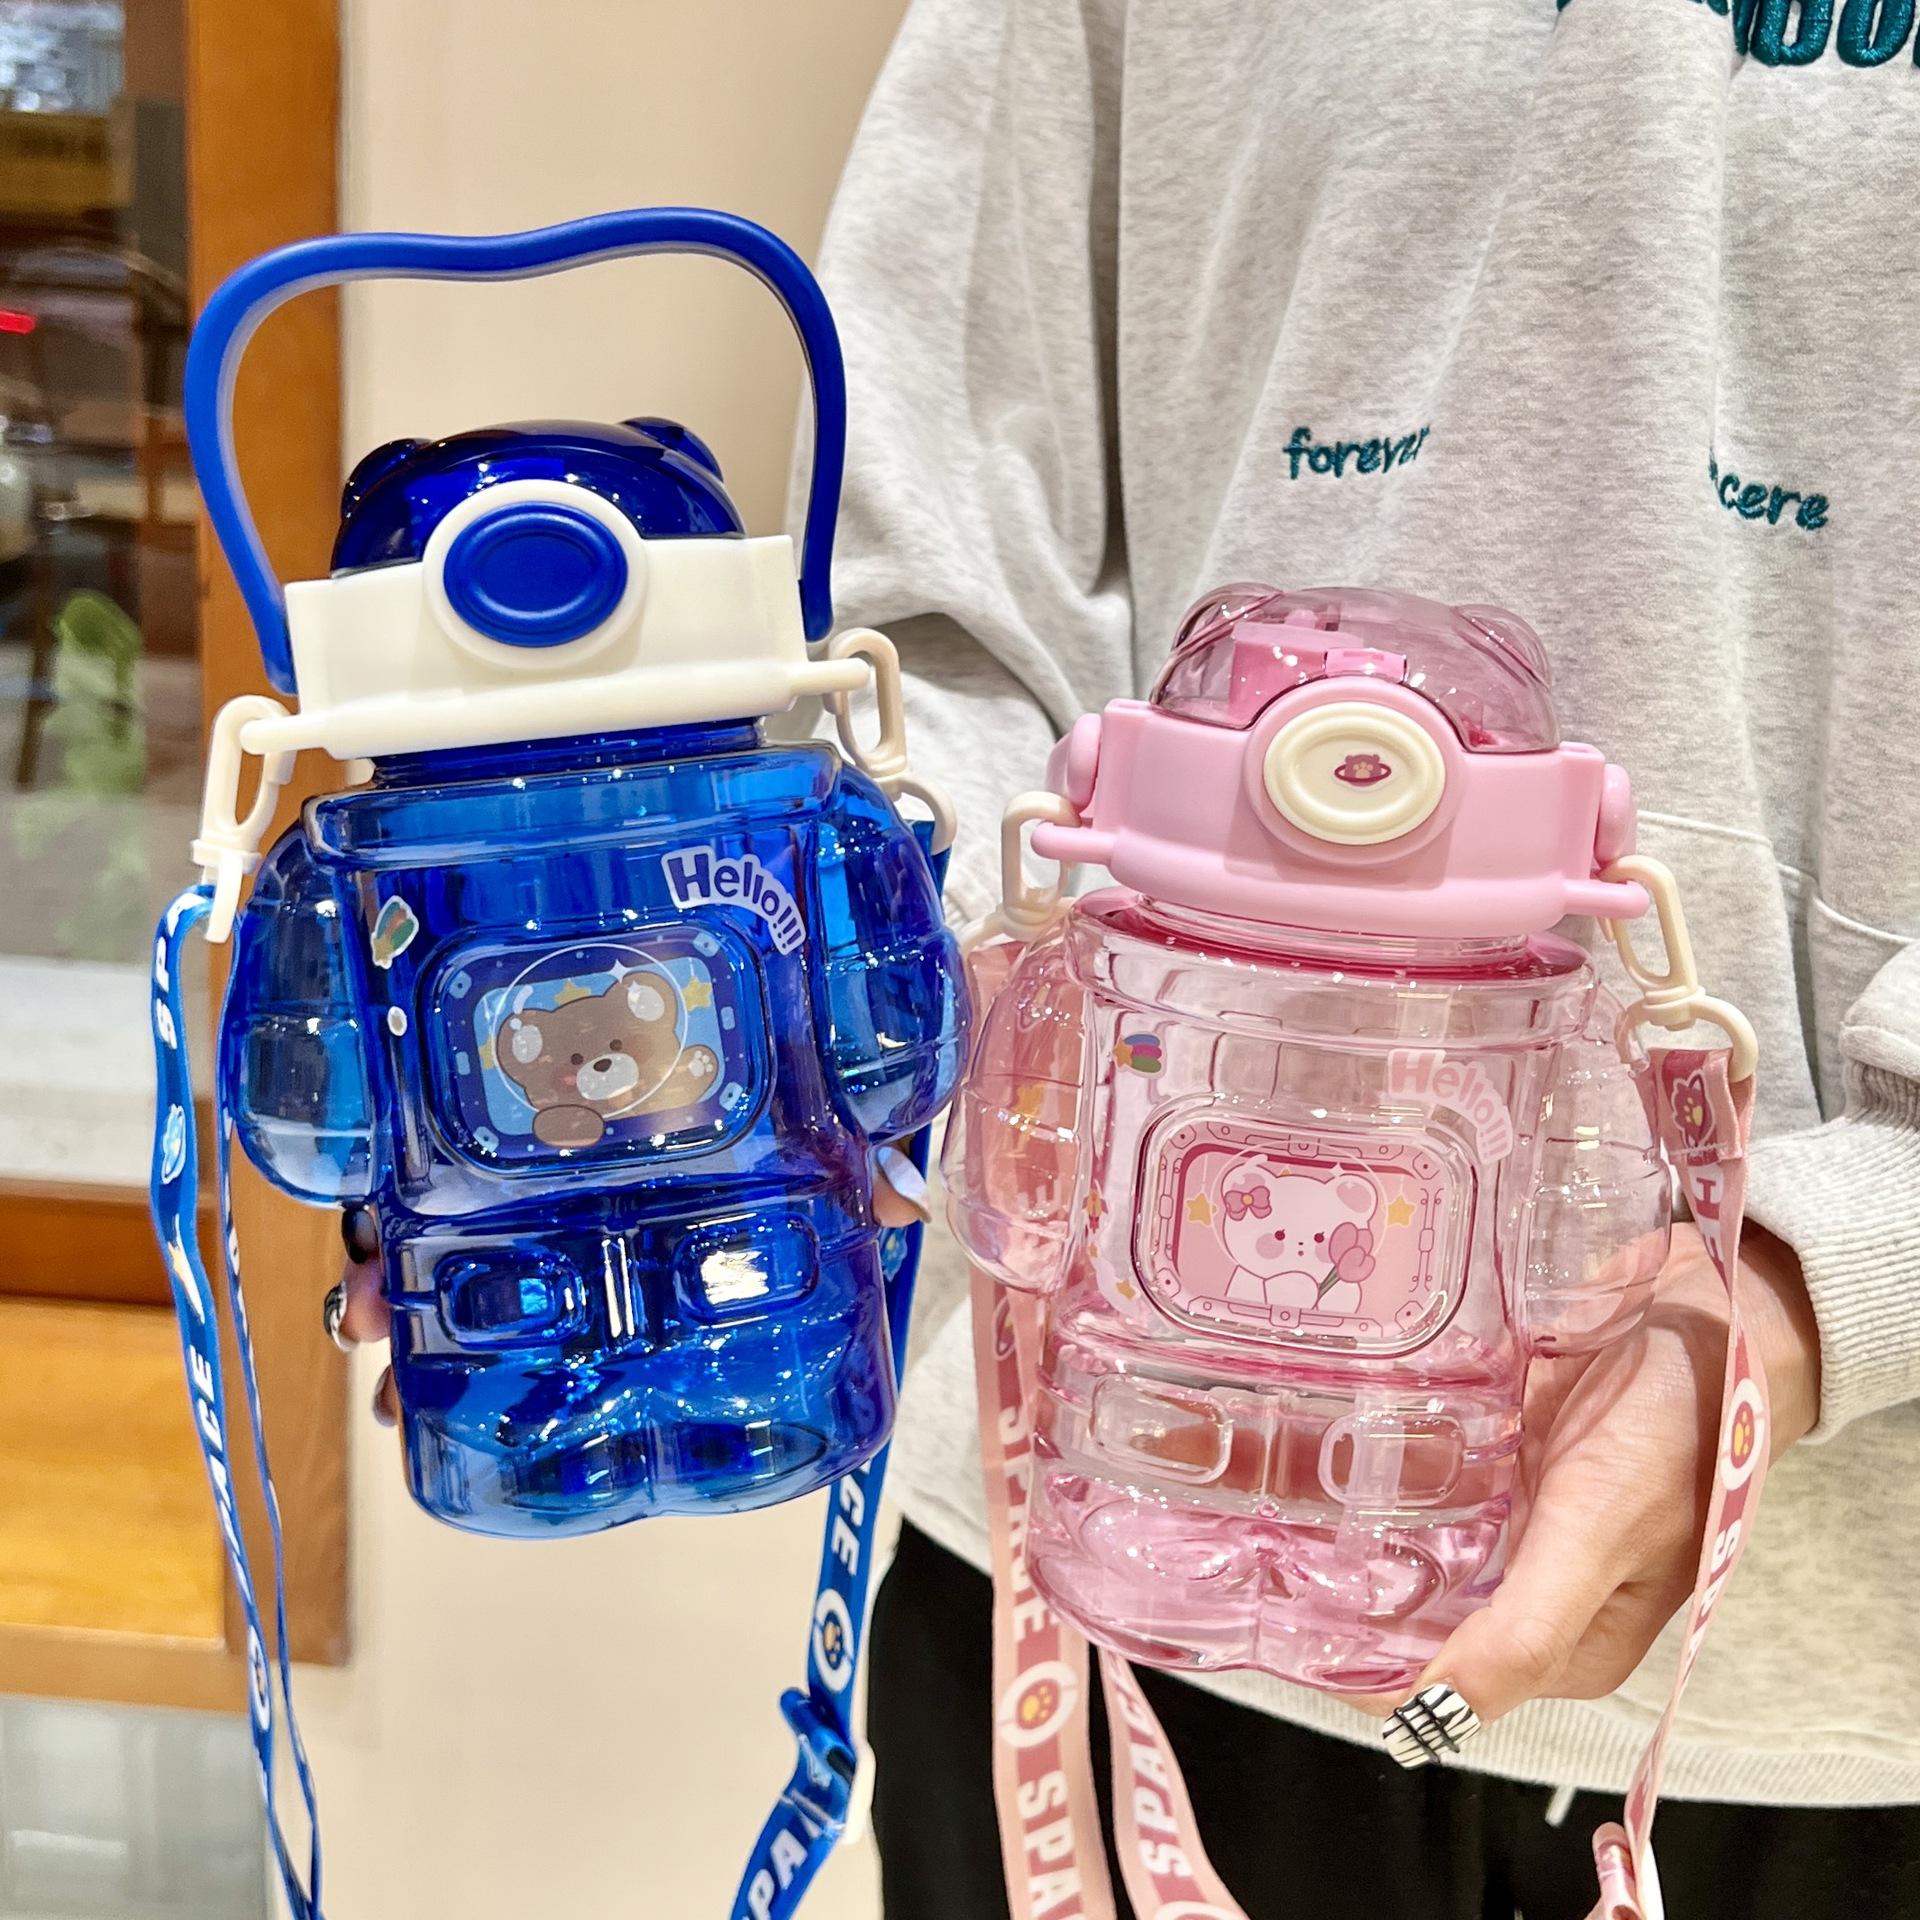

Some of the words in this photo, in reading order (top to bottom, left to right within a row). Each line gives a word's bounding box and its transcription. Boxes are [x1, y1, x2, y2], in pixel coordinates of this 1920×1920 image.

[1708, 447, 1829, 531] cere
[667, 853, 802, 950] Hello!!!
[1390, 1051, 1508, 1158] Hello!!!
[1017, 1770, 1088, 1920] SPA
